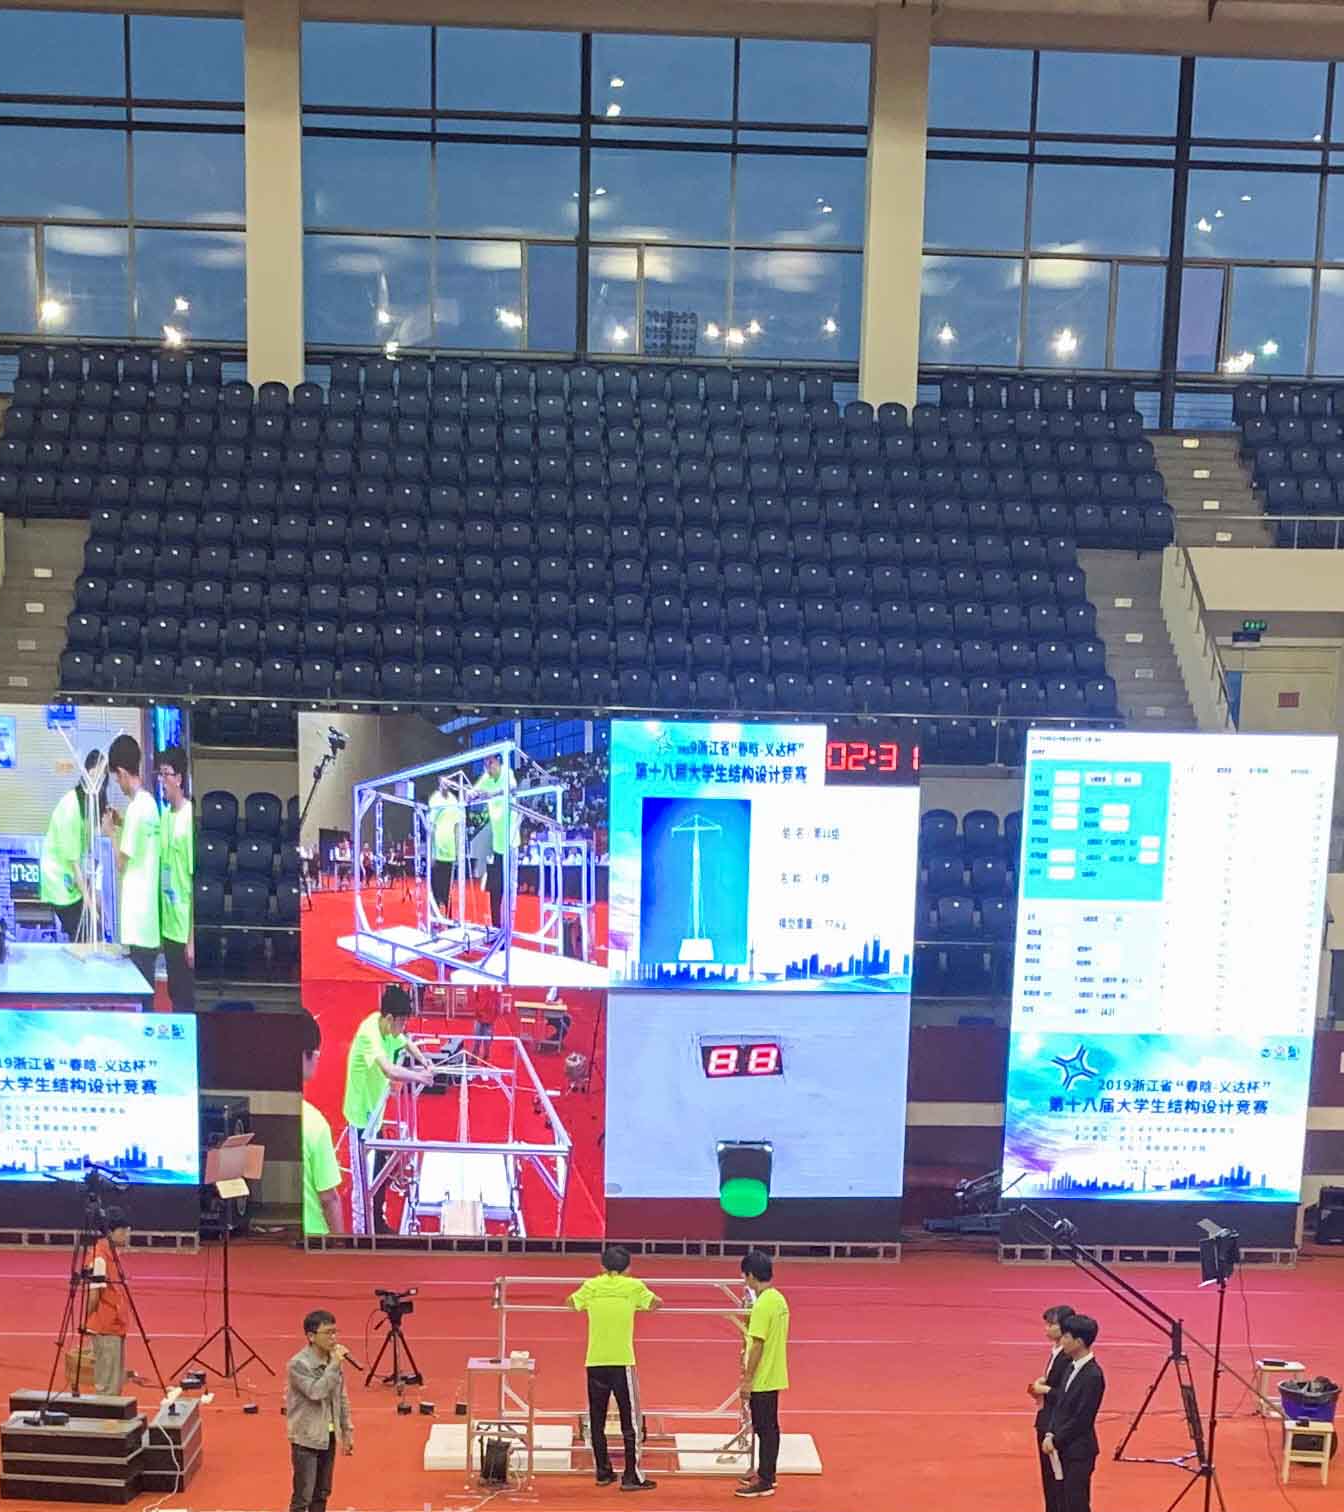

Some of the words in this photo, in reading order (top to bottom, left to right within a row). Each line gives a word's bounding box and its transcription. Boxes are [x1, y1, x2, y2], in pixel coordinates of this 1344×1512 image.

[826, 742, 920, 771] 02:31
[634, 762, 808, 784] 第十八届大学生结构设计竞赛
[1048, 1097, 1269, 1115] 第十八届大学生结构设计竞赛
